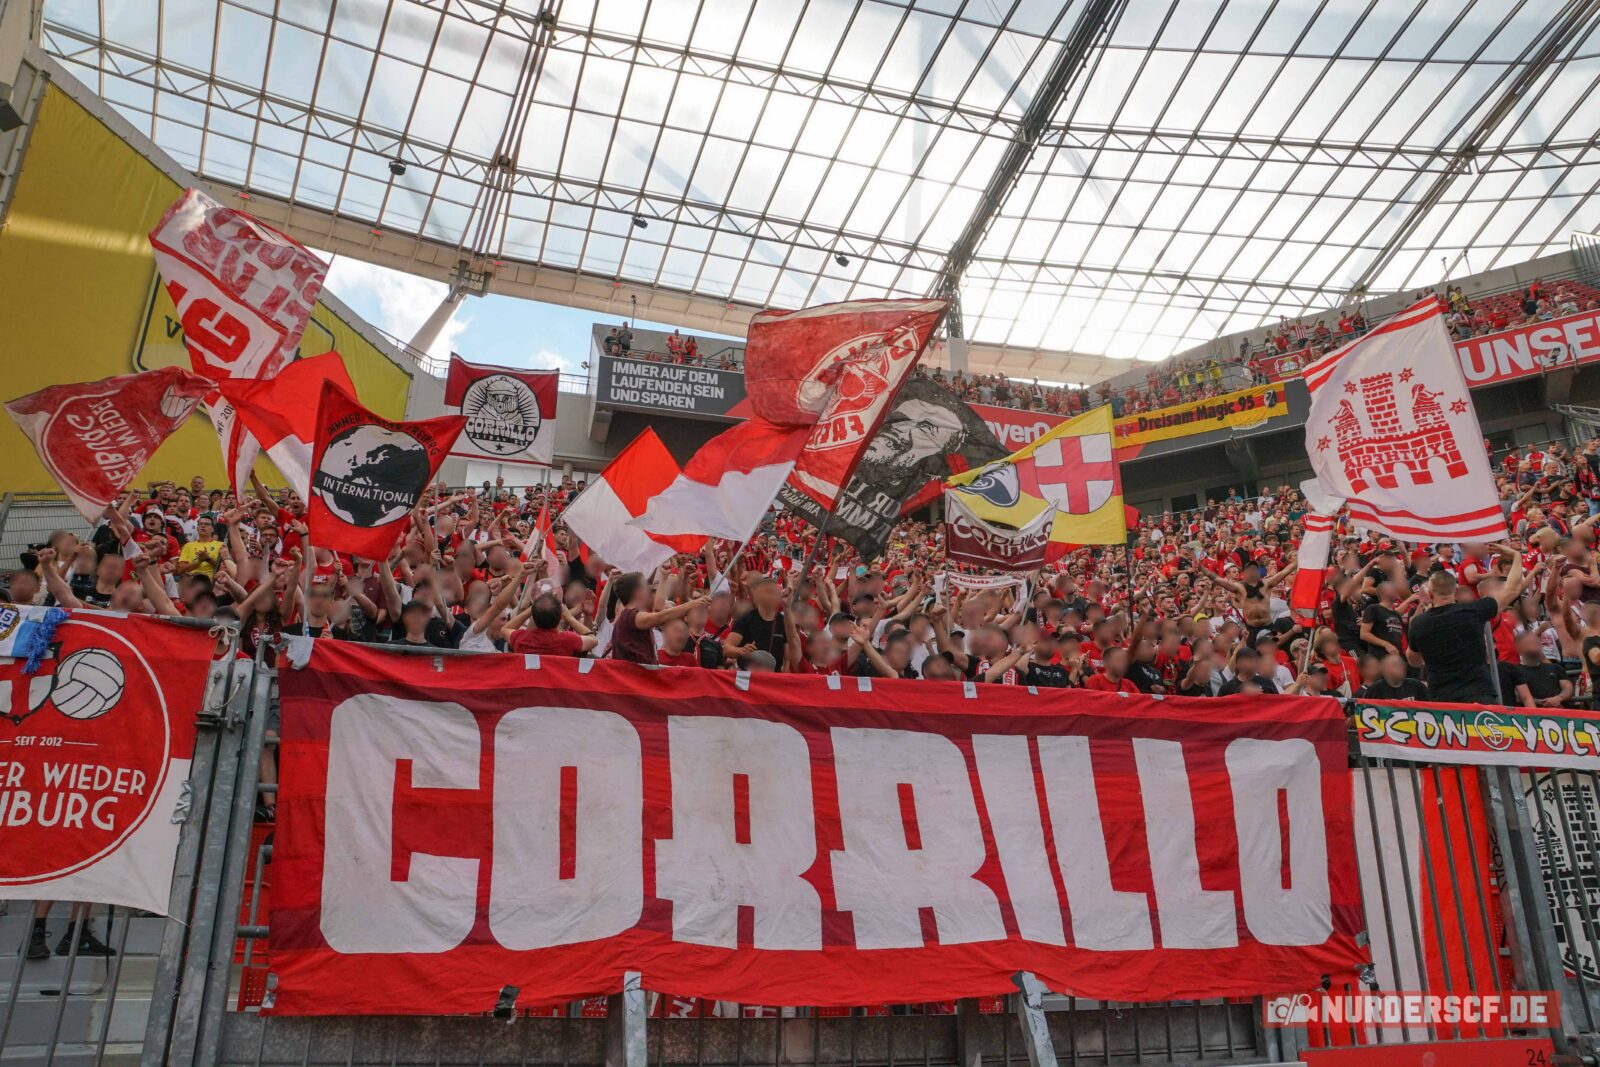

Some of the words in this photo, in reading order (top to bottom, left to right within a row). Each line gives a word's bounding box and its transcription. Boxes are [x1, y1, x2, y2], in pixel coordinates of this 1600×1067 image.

[1458, 316, 1600, 382] UNSE
[612, 361, 660, 378] IMMER
[660, 367, 688, 381] AUF
[688, 370, 719, 385] DEM
[610, 388, 640, 402] UND
[640, 391, 695, 409] SPAREN
[611, 374, 693, 395] LAUFENDEN
[693, 385, 725, 400] SEIN
[221, 403, 234, 420] 201
[1138, 411, 1194, 432] Dreisam
[1196, 401, 1235, 421] Magic
[1238, 395, 1256, 411] 95
[465, 416, 535, 442] CORRILLO
[322, 476, 414, 505] INTERNATIONAL
[1361, 706, 1470, 749] SCON
[14, 735, 37, 746] SEIT
[39, 736, 63, 747] 2012
[43, 762, 147, 795] WIEDER
[320, 693, 1334, 955] CORRILLO
[1526, 1049, 1547, 1066] 24
